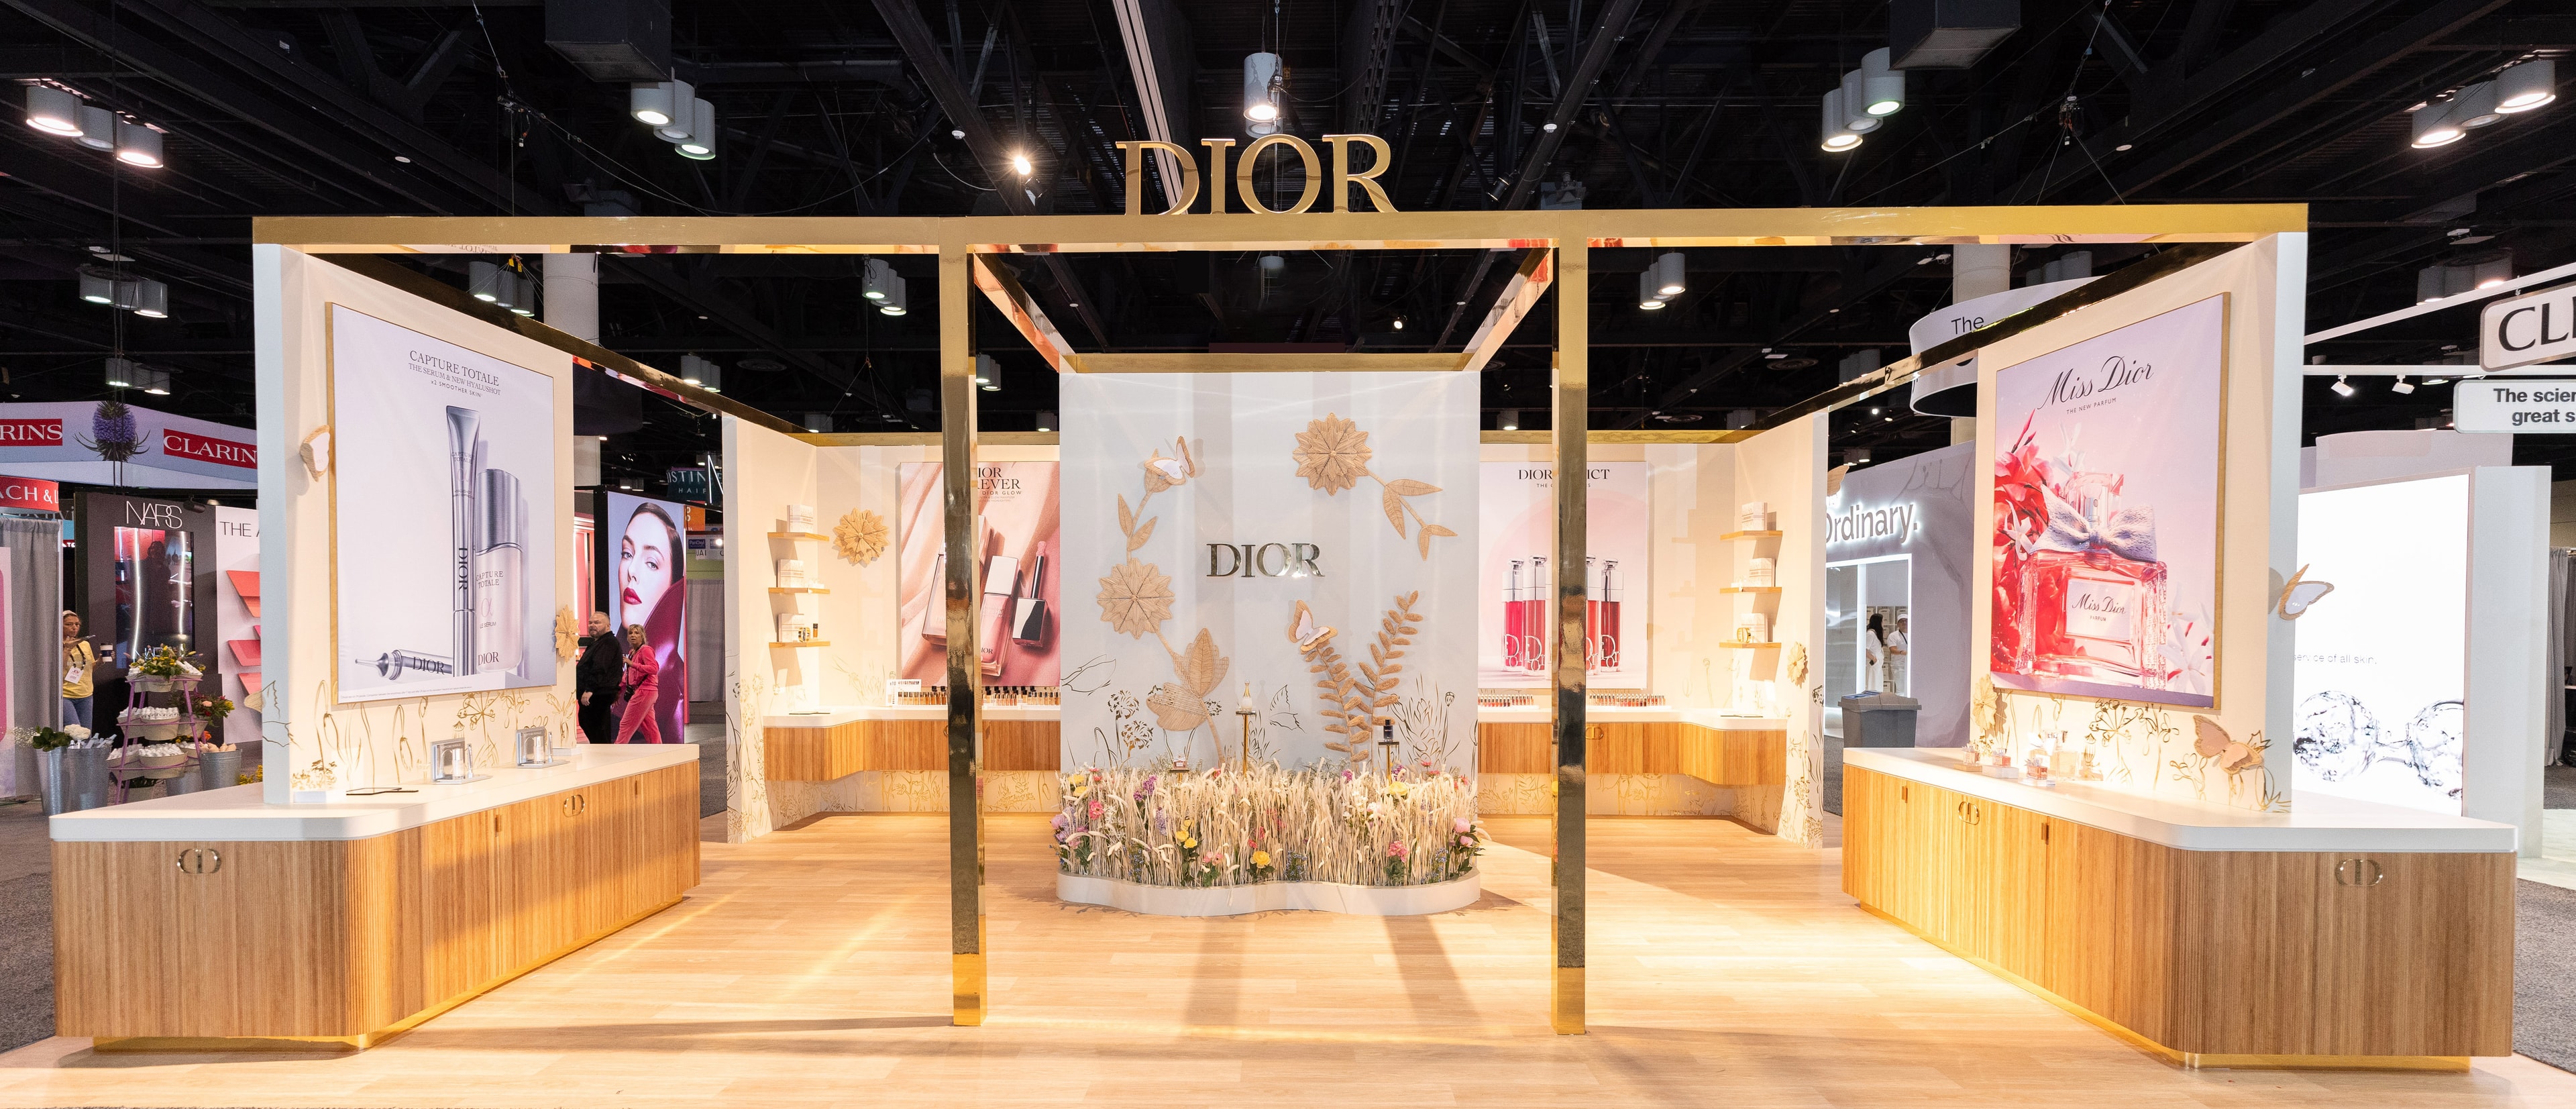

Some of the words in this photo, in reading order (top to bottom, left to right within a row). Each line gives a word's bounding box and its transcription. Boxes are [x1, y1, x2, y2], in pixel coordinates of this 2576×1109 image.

[1116, 134, 1399, 215] DIOR
[1951, 317, 1984, 334] The
[410, 350, 460, 374] CAPTURE
[462, 366, 500, 386] TOTALE
[409, 363, 423, 372] THE
[423, 368, 445, 380] SERUM
[452, 376, 466, 385] NEW
[467, 380, 500, 395] HYALUSHOT
[2037, 368, 2093, 409] Miss
[2098, 356, 2154, 392] Dior
[439, 382, 468, 394] SMOOTHER
[2493, 388, 2528, 403] The
[2094, 397, 2116, 408] PARFUM
[2512, 409, 2560, 426] great
[978, 467, 1002, 478] IOR
[1519, 469, 1552, 480] DIOR
[1587, 469, 1610, 480] ICT
[977, 479, 1021, 489] EVER
[0, 486, 38, 502] CH
[126, 500, 182, 529] NARS
[220, 521, 252, 537] THE
[459, 547, 468, 590] DIOR
[1206, 543, 1326, 578] DIOR
[476, 571, 504, 582] CAPTURE
[478, 579, 500, 589] TOTALE
[2072, 593, 2100, 611] Miss
[2102, 596, 2127, 614] Dior
[413, 656, 445, 675] DIOR
[478, 651, 499, 666] DIOR
[2340, 655, 2351, 663] all
